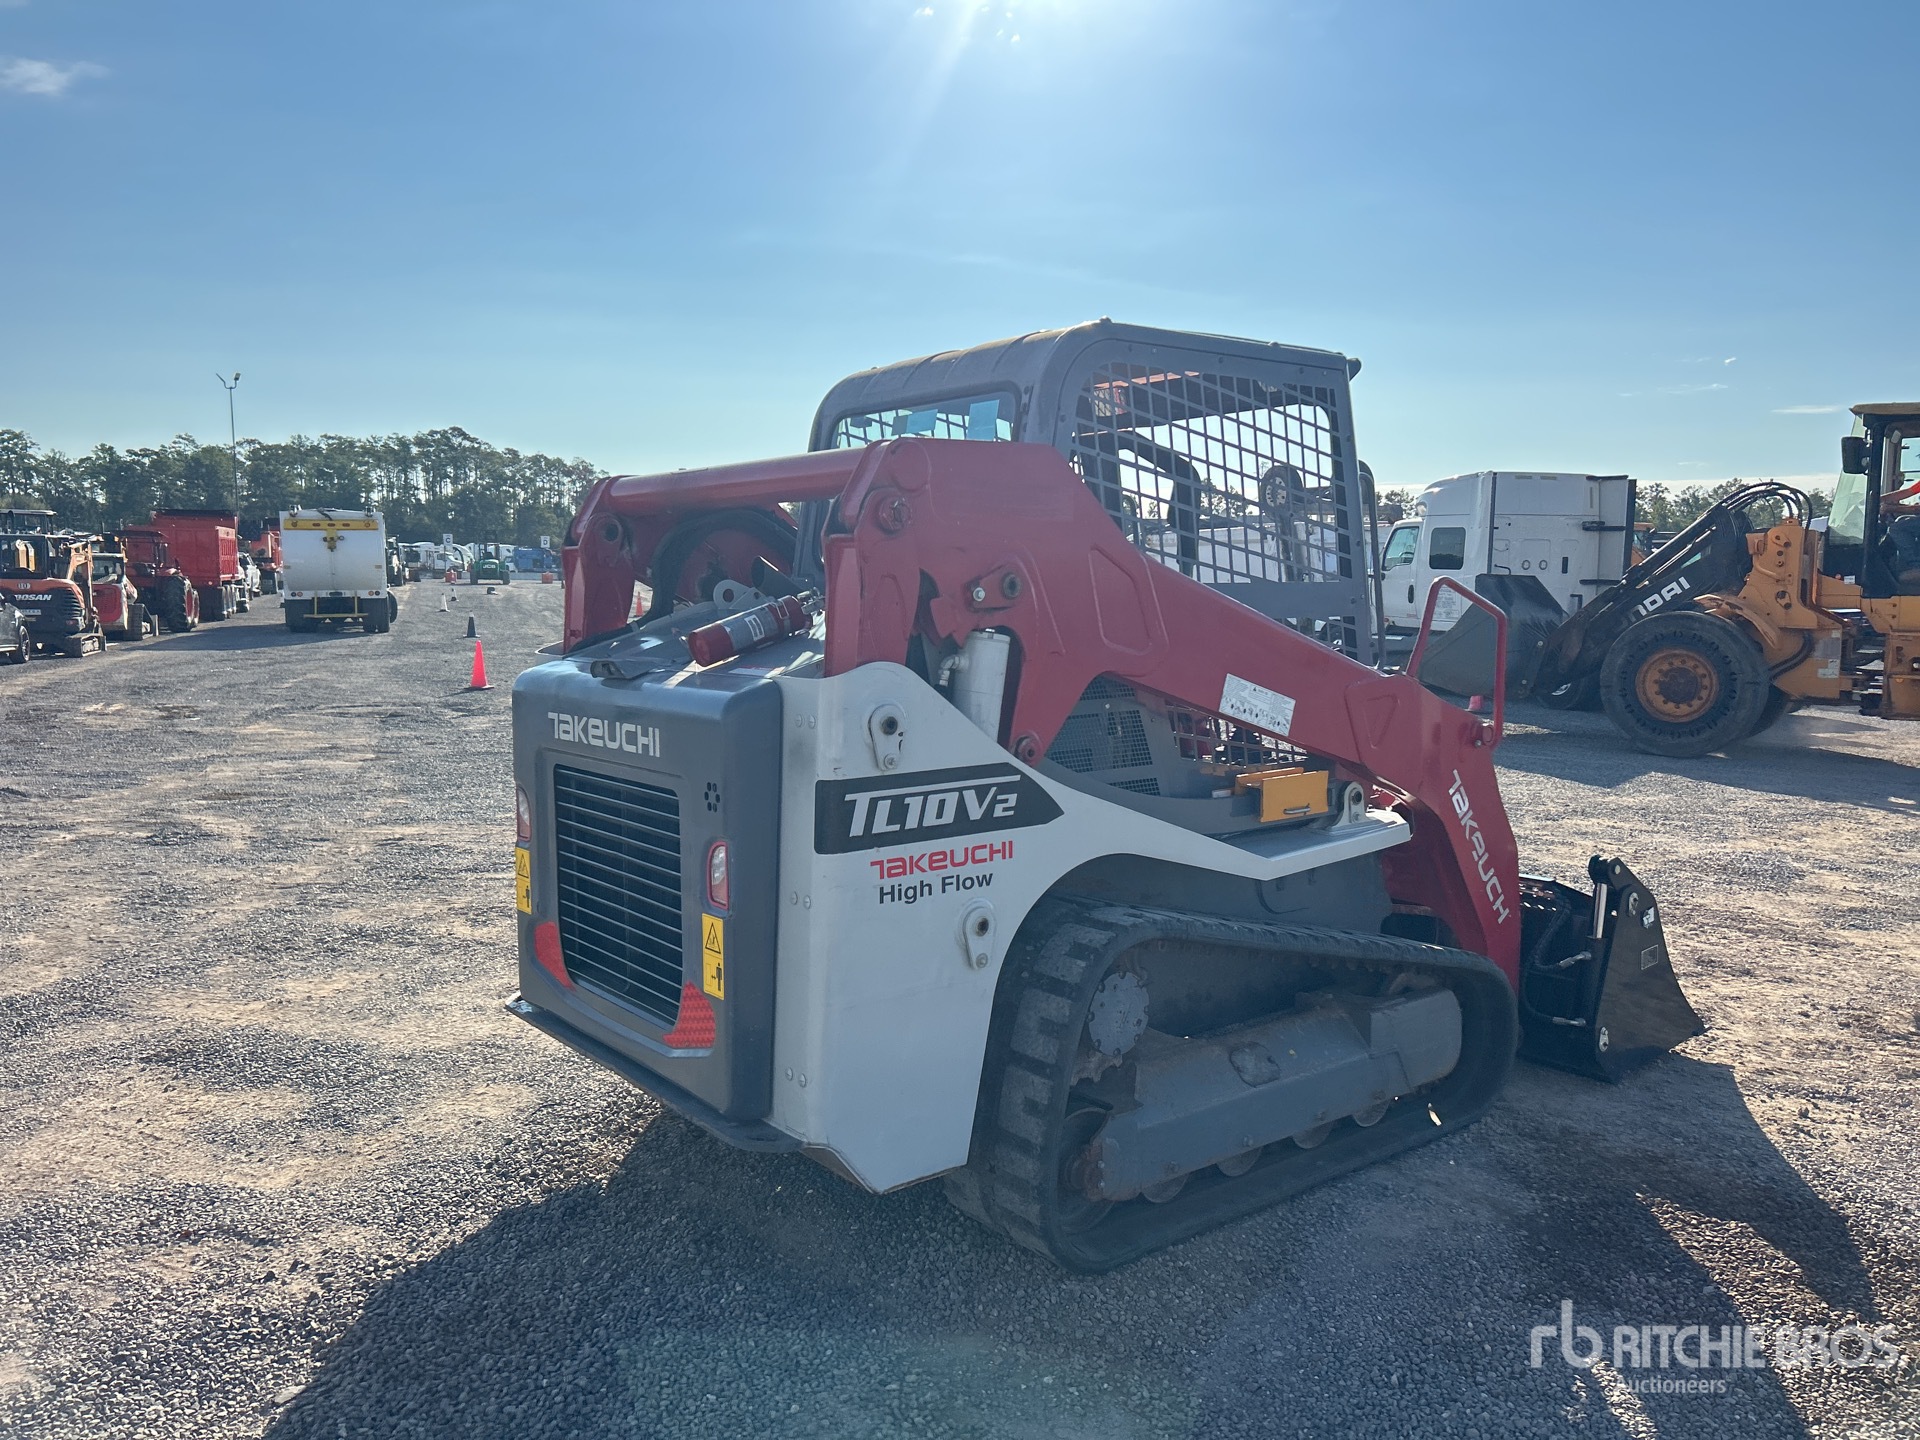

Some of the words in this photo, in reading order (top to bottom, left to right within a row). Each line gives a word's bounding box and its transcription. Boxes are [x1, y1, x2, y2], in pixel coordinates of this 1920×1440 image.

[547, 711, 660, 758] TAKEUCHI
[844, 776, 1021, 838] TL10V2
[870, 840, 1013, 880] TAKEUCHI
[879, 880, 933, 904] High
[941, 873, 993, 894] Flow
